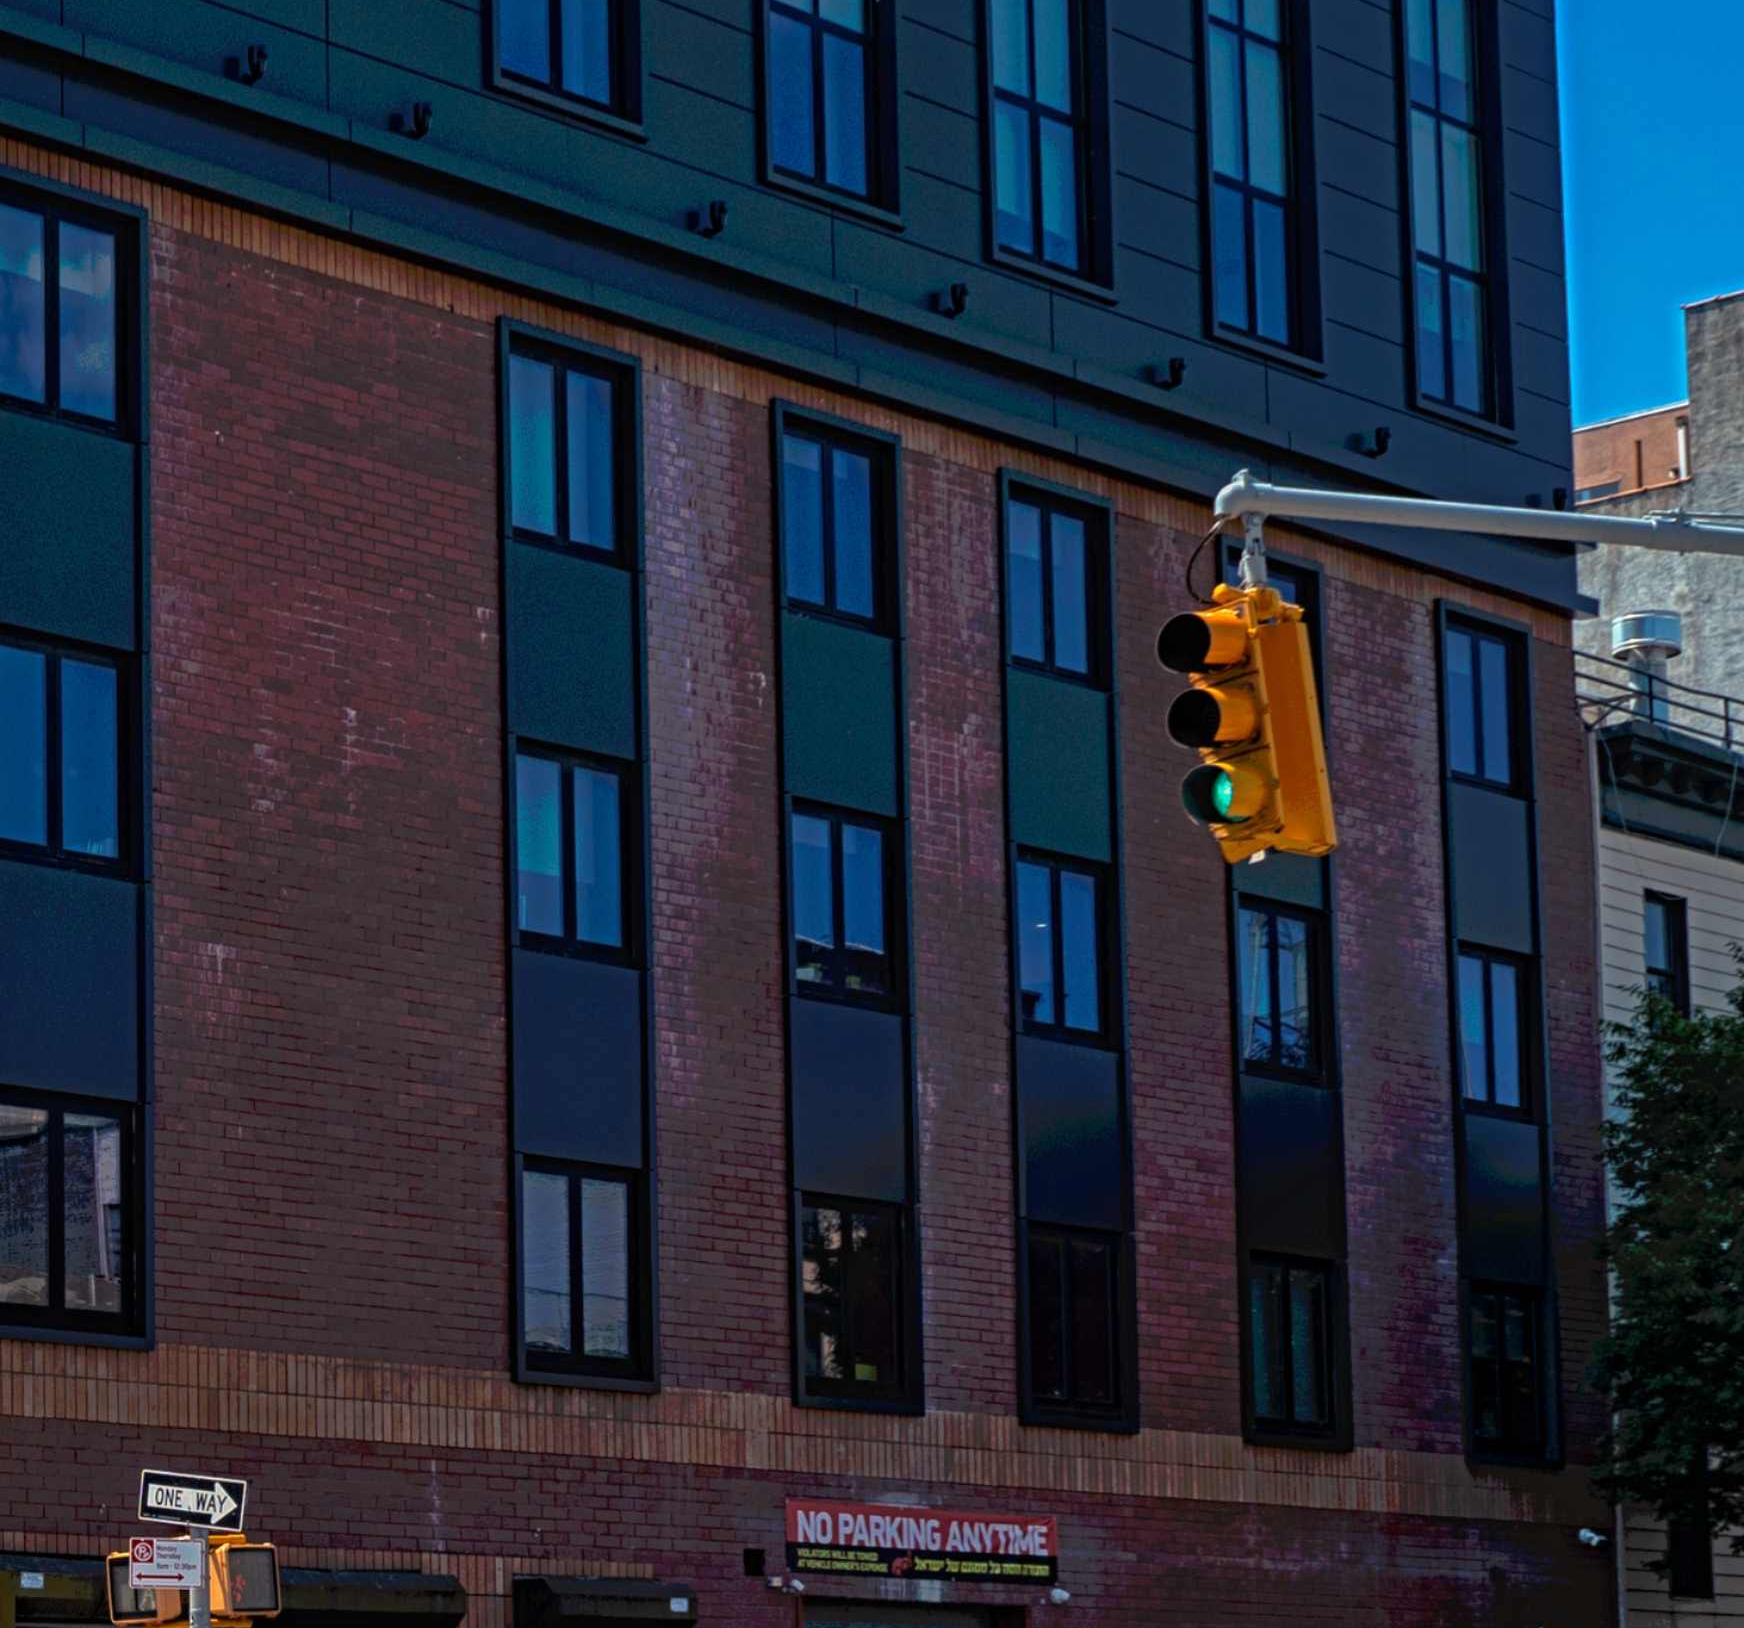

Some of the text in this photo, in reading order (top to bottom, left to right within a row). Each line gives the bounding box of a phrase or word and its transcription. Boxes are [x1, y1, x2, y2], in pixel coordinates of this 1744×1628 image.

[155, 1487, 228, 1513] ONE WAY
[797, 1509, 1049, 1556] NO PARKING ANYTIME
[157, 1545, 177, 1553] Monday
[157, 1553, 181, 1561] Thursday
